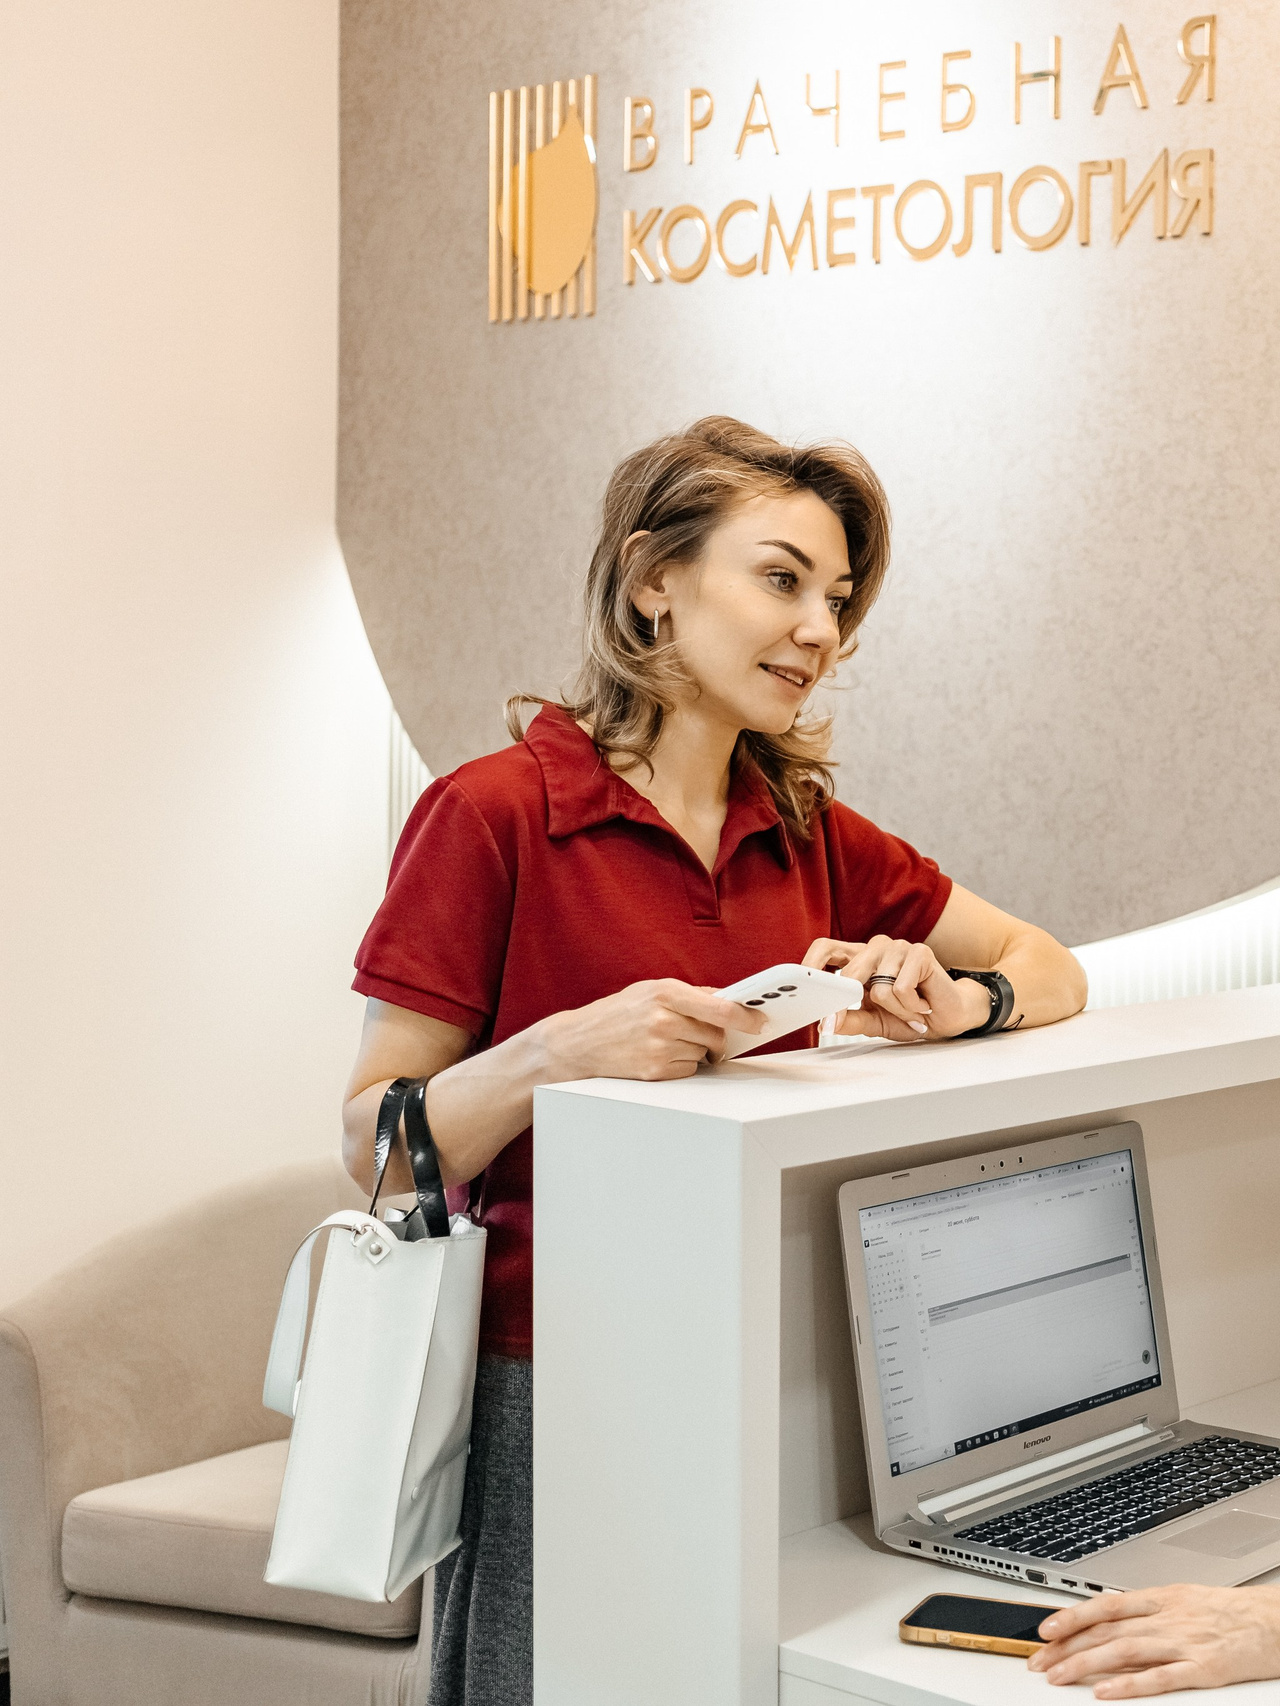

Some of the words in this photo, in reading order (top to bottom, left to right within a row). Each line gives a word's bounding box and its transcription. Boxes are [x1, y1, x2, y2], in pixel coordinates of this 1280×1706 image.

[623, 14, 1218, 173] ВРАЧЕБНАЯ
[622, 147, 1216, 286] КОСМЕТОЛОГИЯ
[1023, 1435, 1052, 1450] lenovo
